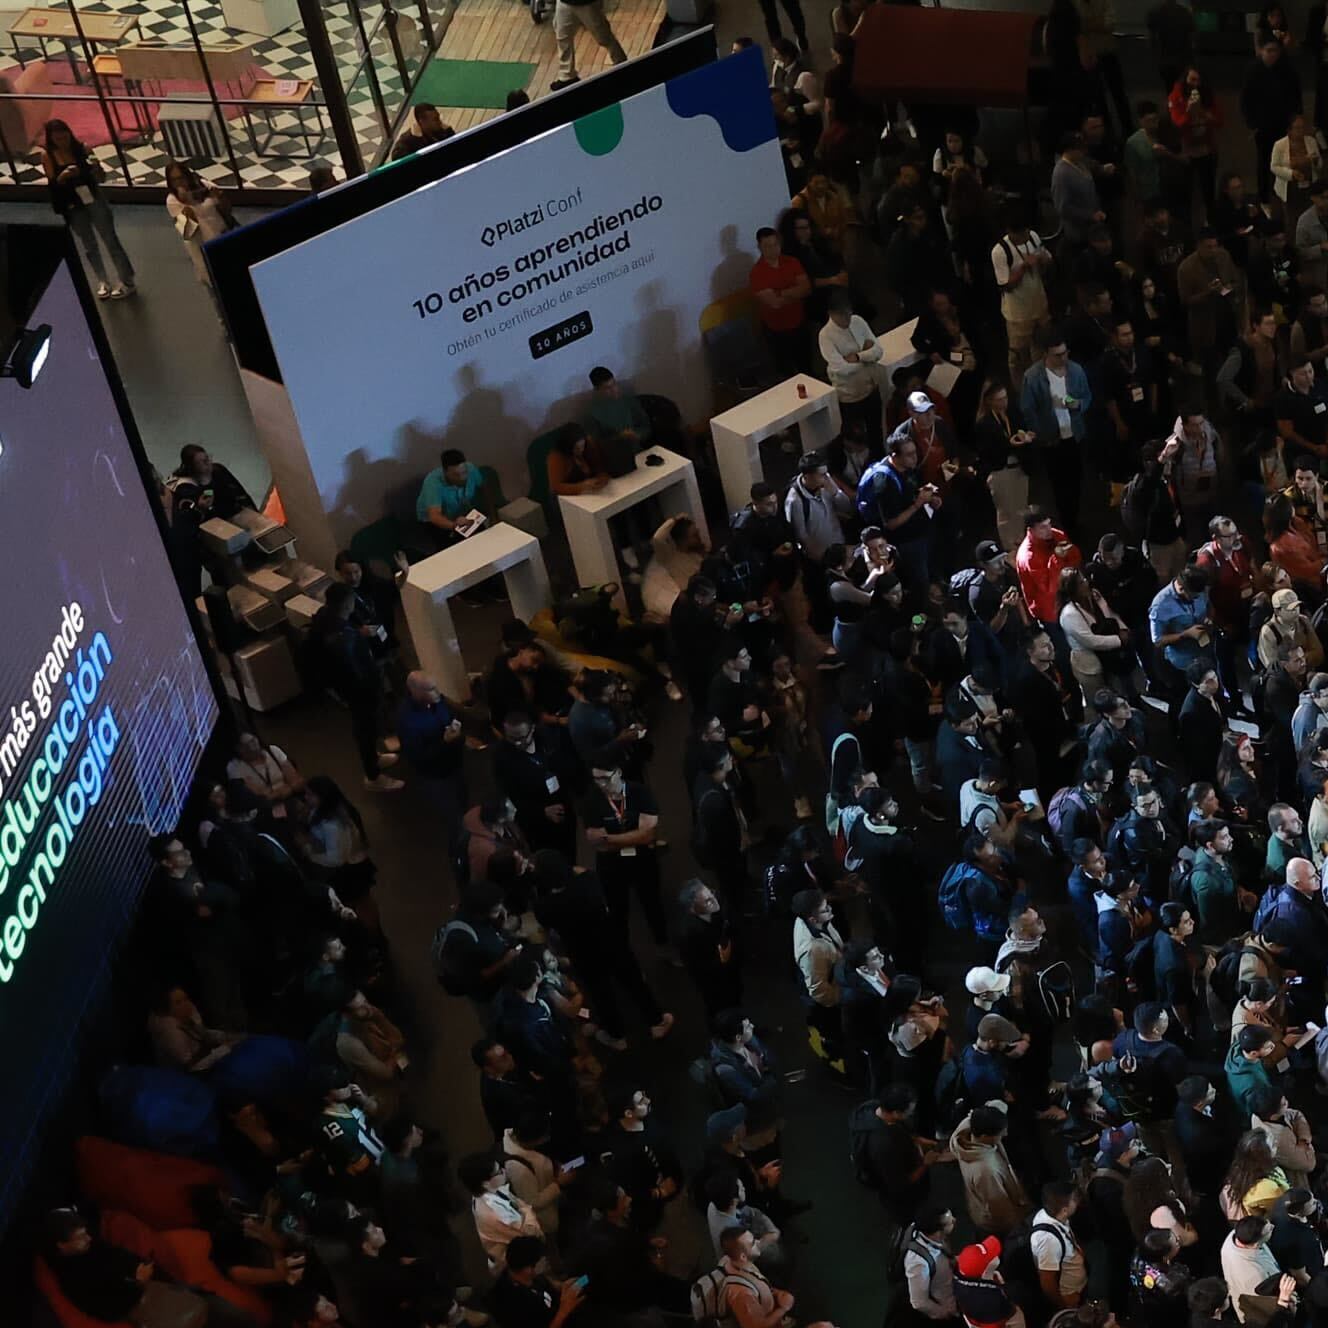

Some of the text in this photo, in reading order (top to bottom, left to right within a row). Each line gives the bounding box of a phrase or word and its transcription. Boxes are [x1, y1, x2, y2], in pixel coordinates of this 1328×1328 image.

[412, 195, 663, 319] 10 años aprendiendo
[496, 187, 583, 241] Platzi Conf
[447, 332, 482, 356] Obtén
[484, 326, 497, 345] tu
[499, 297, 558, 331] certificado
[559, 290, 574, 304] de
[575, 264, 630, 297] asistencia
[462, 230, 631, 323] en comunidad
[536, 320, 588, 351] 10 AÑOS
[0, 600, 84, 778] más grande
[322, 1121, 344, 1141] 12
